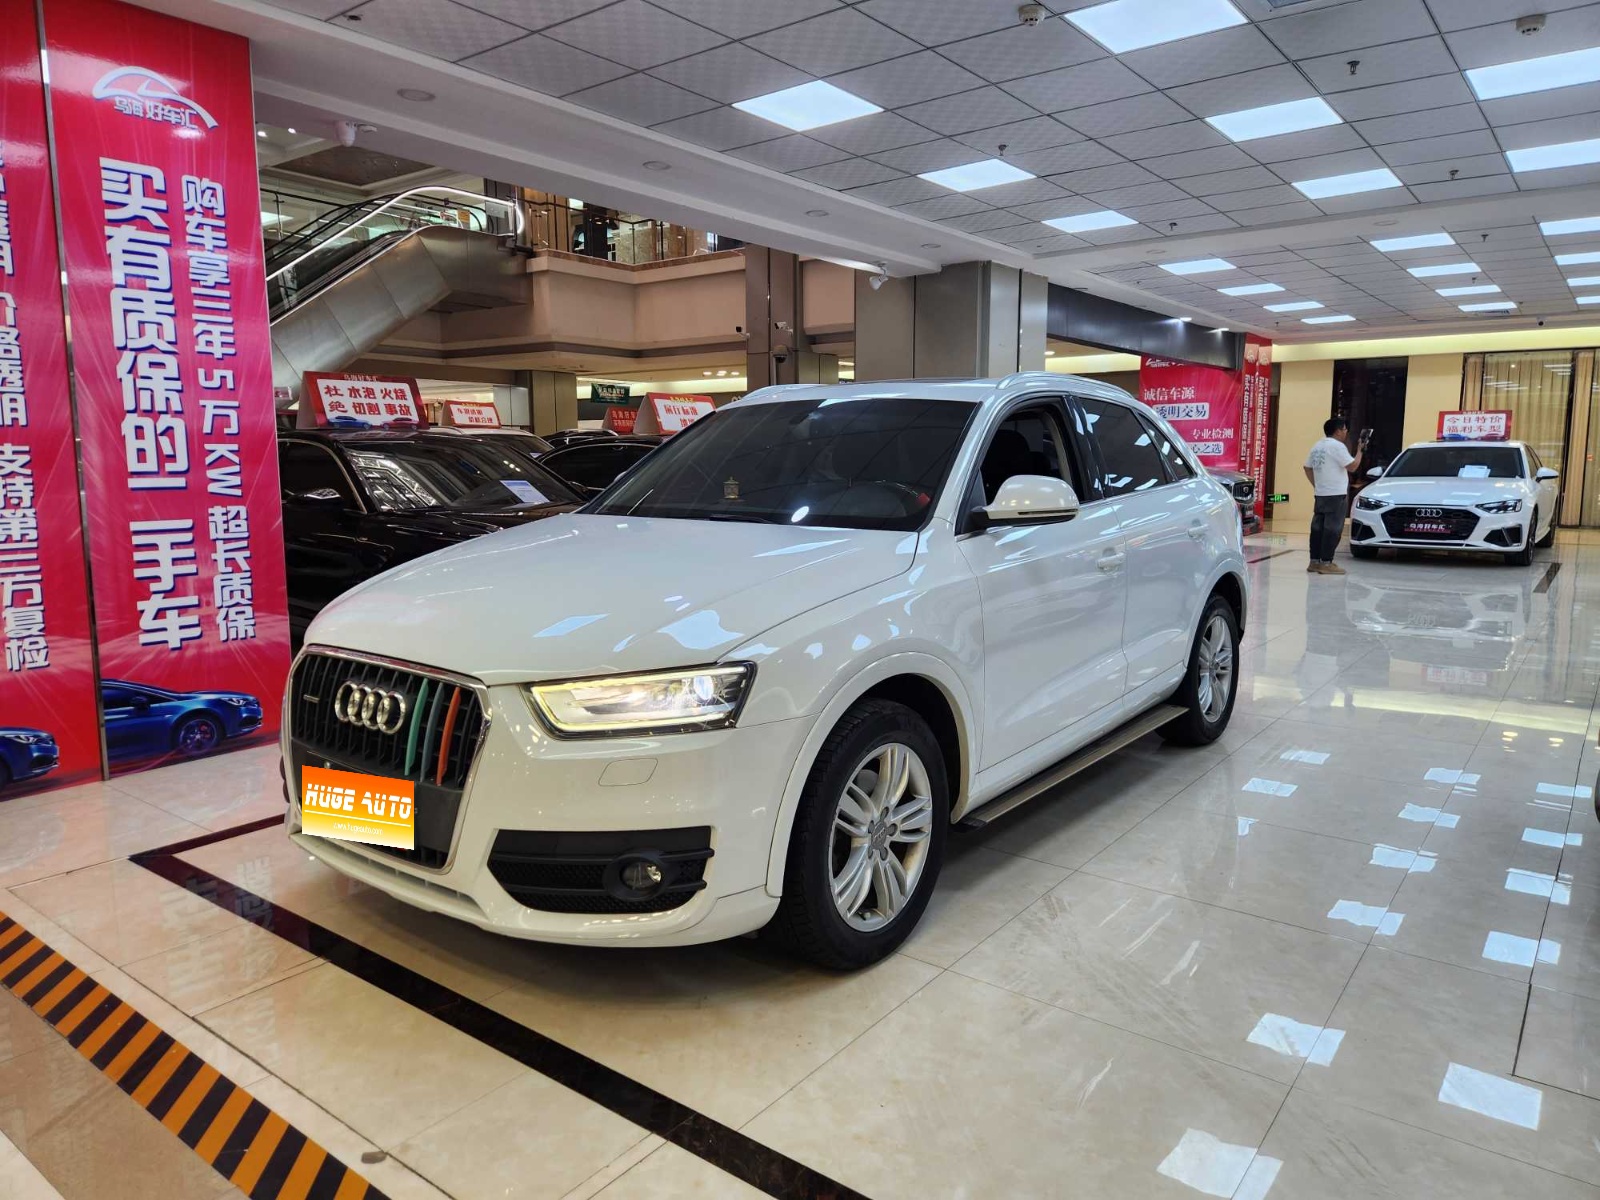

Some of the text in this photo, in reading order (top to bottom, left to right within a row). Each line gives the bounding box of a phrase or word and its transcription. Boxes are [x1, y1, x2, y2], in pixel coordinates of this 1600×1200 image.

[324, 384, 408, 401] 杜 水泡 火烧
[1144, 386, 1195, 401] 诚信车源
[99, 157, 202, 649] 买有质保的二手车
[328, 401, 412, 416] 绝 切割 事故
[1156, 405, 1207, 419] 透明交易
[1446, 415, 1503, 424] 今日特价
[1192, 427, 1234, 440] 专业检测
[0, 443, 50, 671] 支持第三方复检
